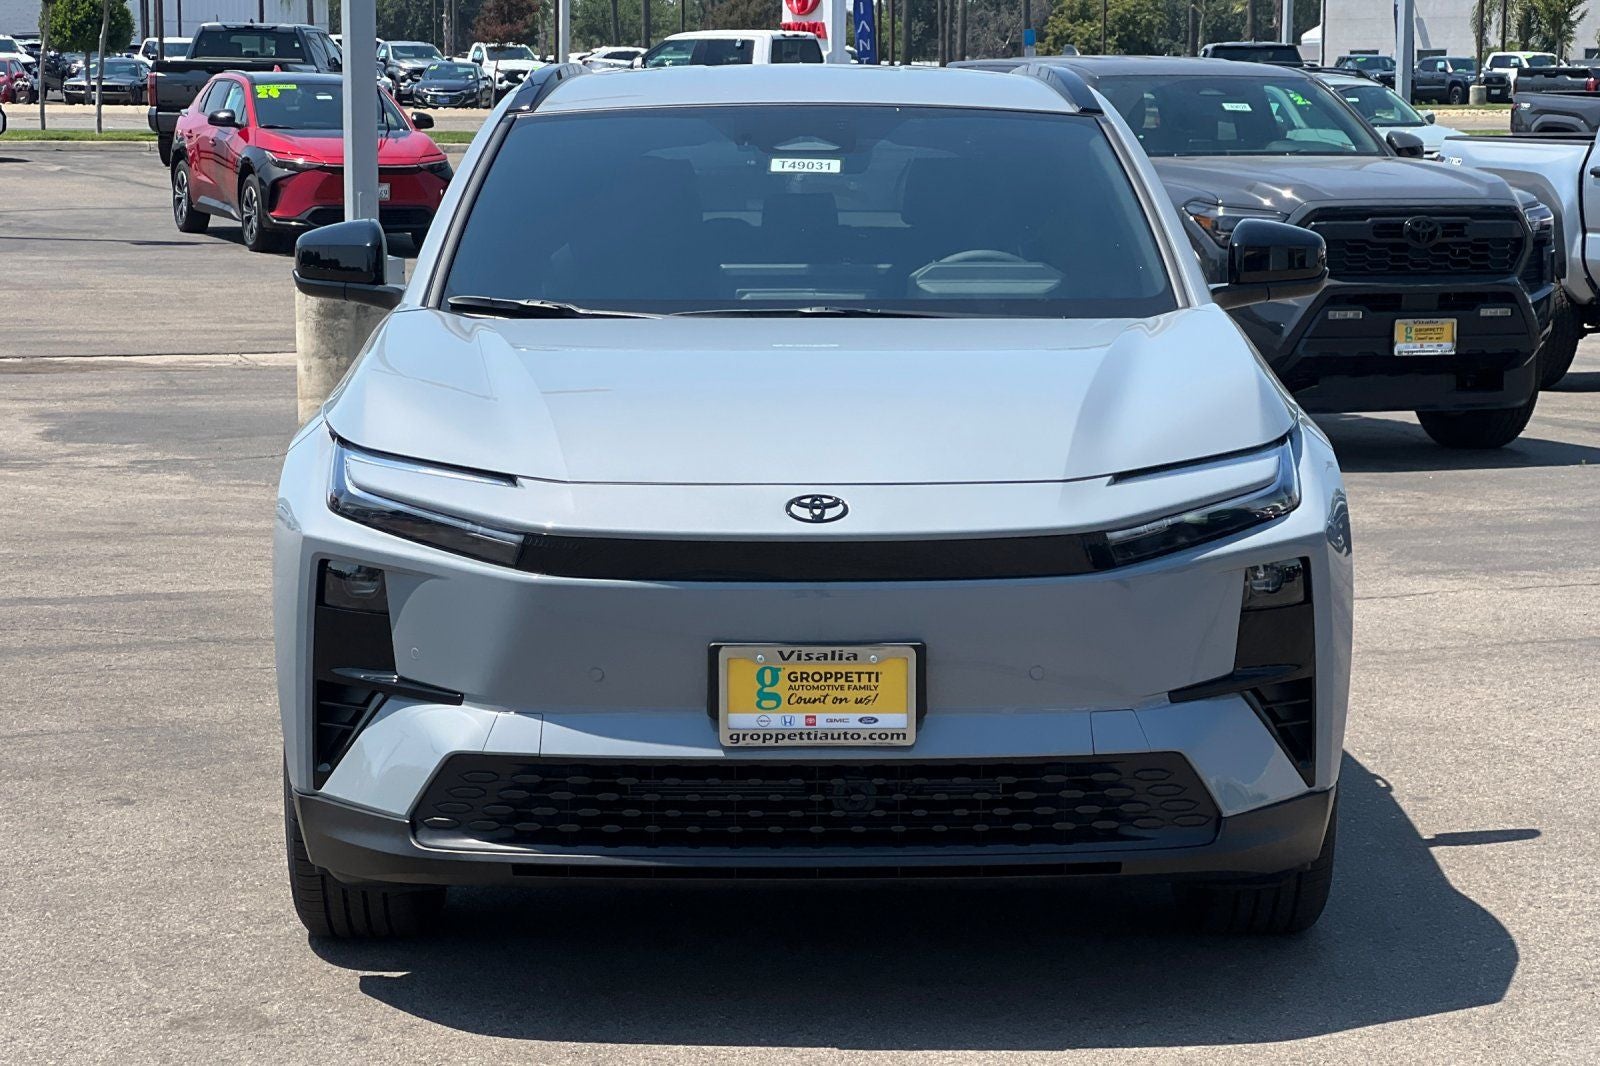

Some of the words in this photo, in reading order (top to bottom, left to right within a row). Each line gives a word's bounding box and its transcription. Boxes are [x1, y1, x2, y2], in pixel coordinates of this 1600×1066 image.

[779, 160, 831, 171] T49031
[777, 649, 858, 662] Visalia
[787, 671, 880, 683] GROPPETTI
[787, 692, 829, 706] Count
[831, 696, 850, 705] on
[854, 692, 878, 706] us!
[729, 730, 907, 744] groppettiauto.com
